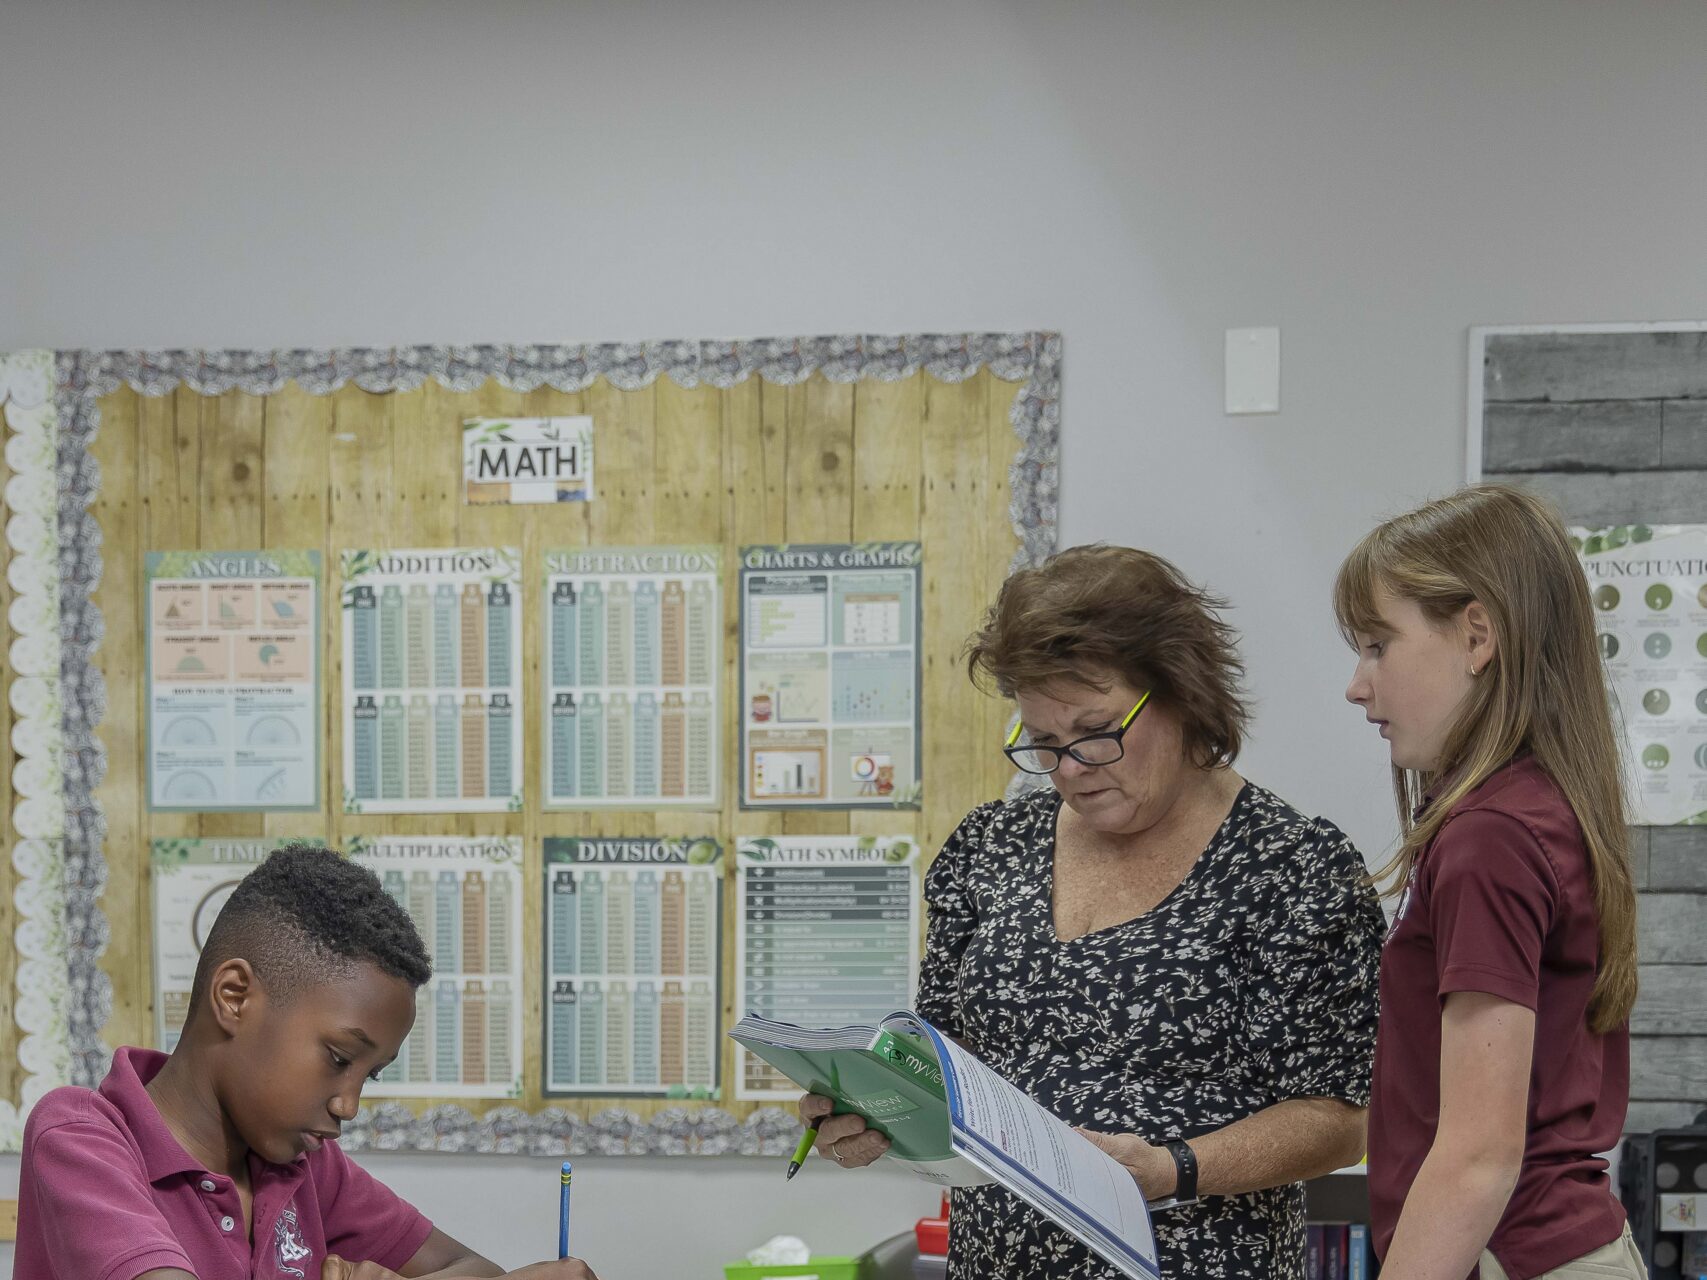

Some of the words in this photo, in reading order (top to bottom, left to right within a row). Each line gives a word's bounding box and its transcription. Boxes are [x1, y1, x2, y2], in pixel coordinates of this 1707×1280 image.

[479, 446, 577, 478] MATH
[188, 559, 283, 577] ANGLES
[375, 555, 494, 575] ADDITION
[547, 552, 717, 574] SUBTRACTION
[745, 552, 819, 569] CHARTS
[820, 551, 836, 568] &
[838, 549, 914, 567] GRAPHS
[577, 841, 688, 862] DIVISION
[757, 848, 811, 863] MATH
[814, 848, 902, 862] SYMBOLS
[883, 1040, 894, 1054] 4.1
[905, 1054, 945, 1087] myVie
